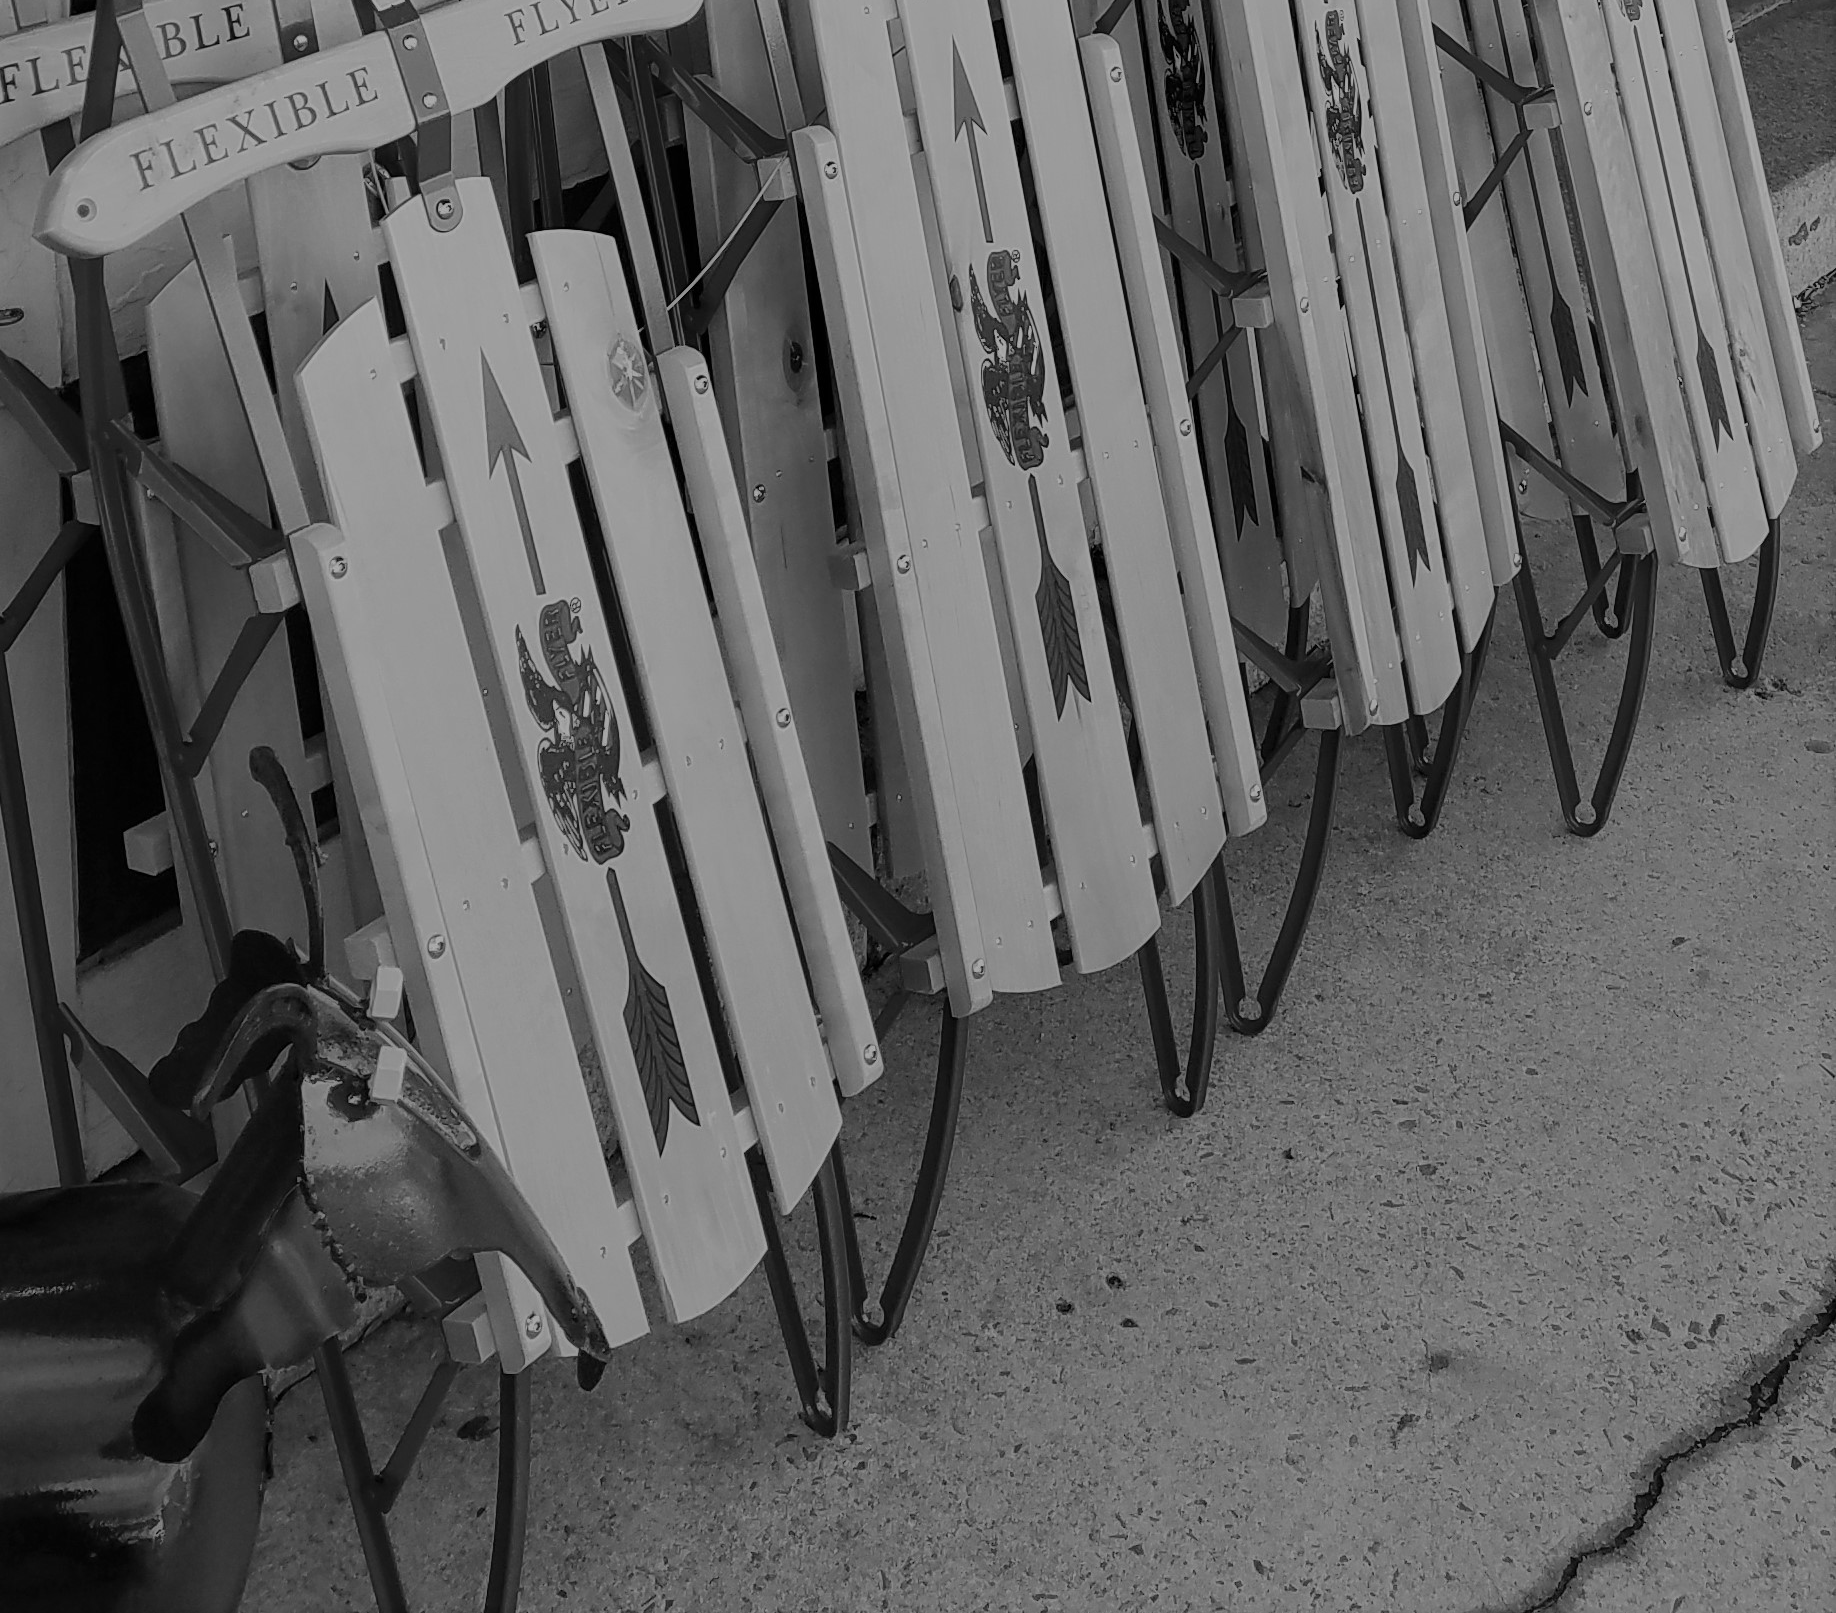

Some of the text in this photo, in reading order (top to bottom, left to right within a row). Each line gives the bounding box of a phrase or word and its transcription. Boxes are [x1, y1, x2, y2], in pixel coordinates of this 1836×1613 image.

[0, 3, 251, 104] FLEBLE
[129, 66, 379, 192] FLEXIBLE
[543, 609, 612, 855] FLEXIBLE FLYER
